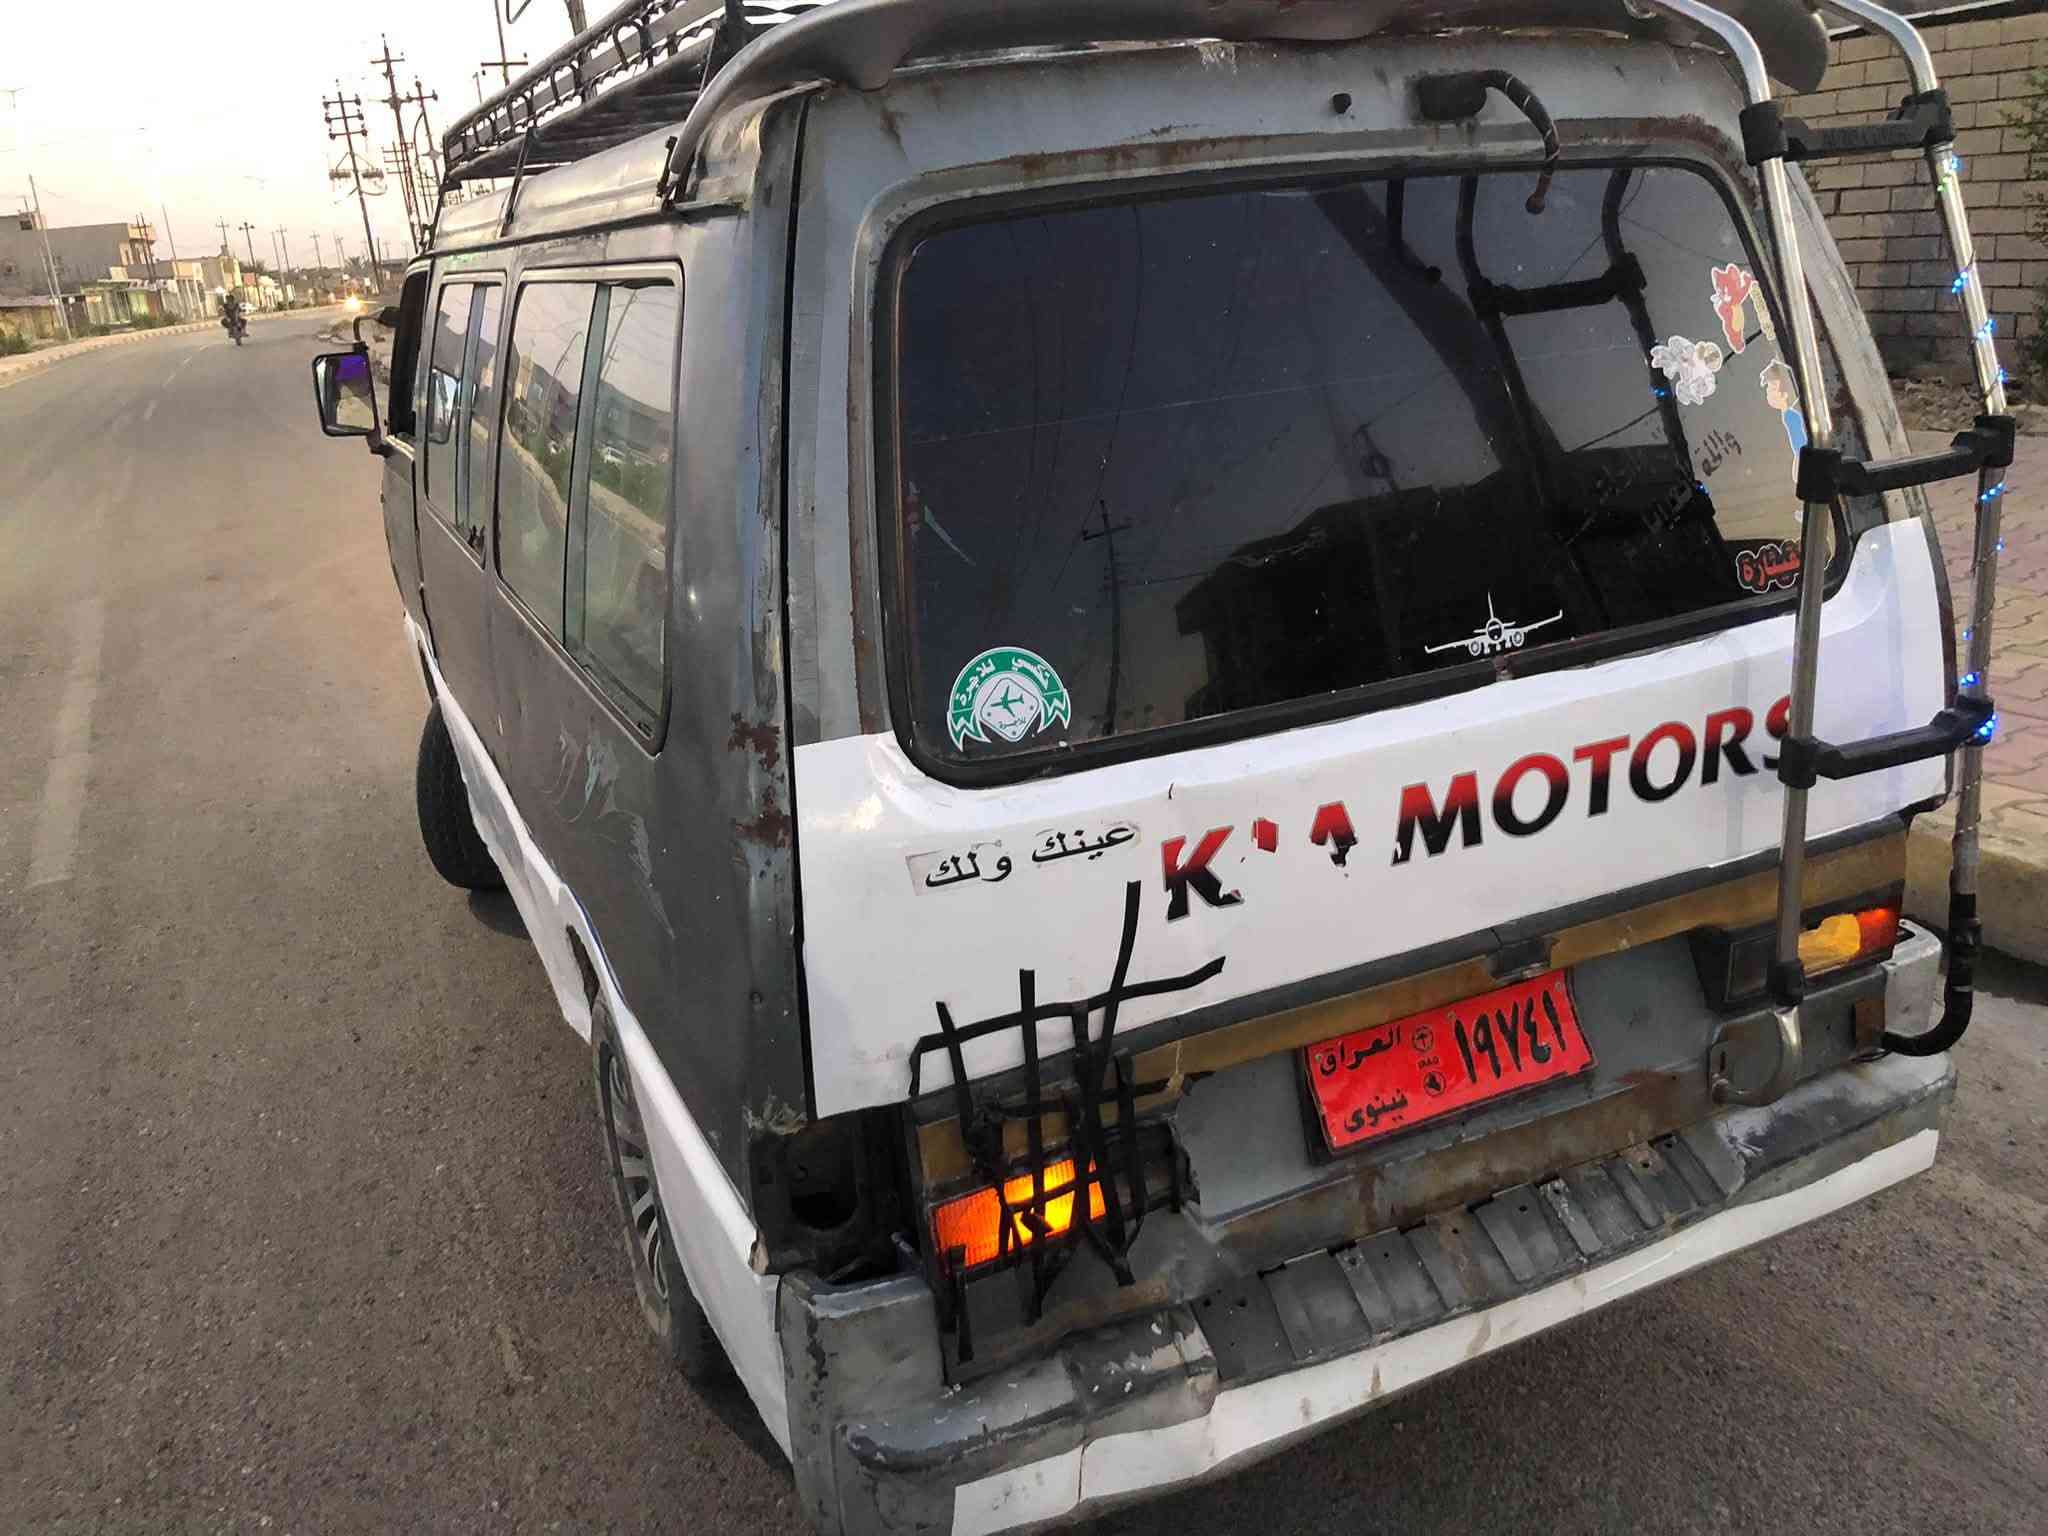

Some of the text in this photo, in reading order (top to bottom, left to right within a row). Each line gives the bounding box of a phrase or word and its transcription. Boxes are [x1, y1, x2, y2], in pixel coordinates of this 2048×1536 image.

[1031, 826, 1136, 862] عينك
[1318, 1025, 1402, 1077] العراق
[1454, 989, 1567, 1084] ١٩٧٤١
[1343, 1086, 1409, 1133] نينوى
